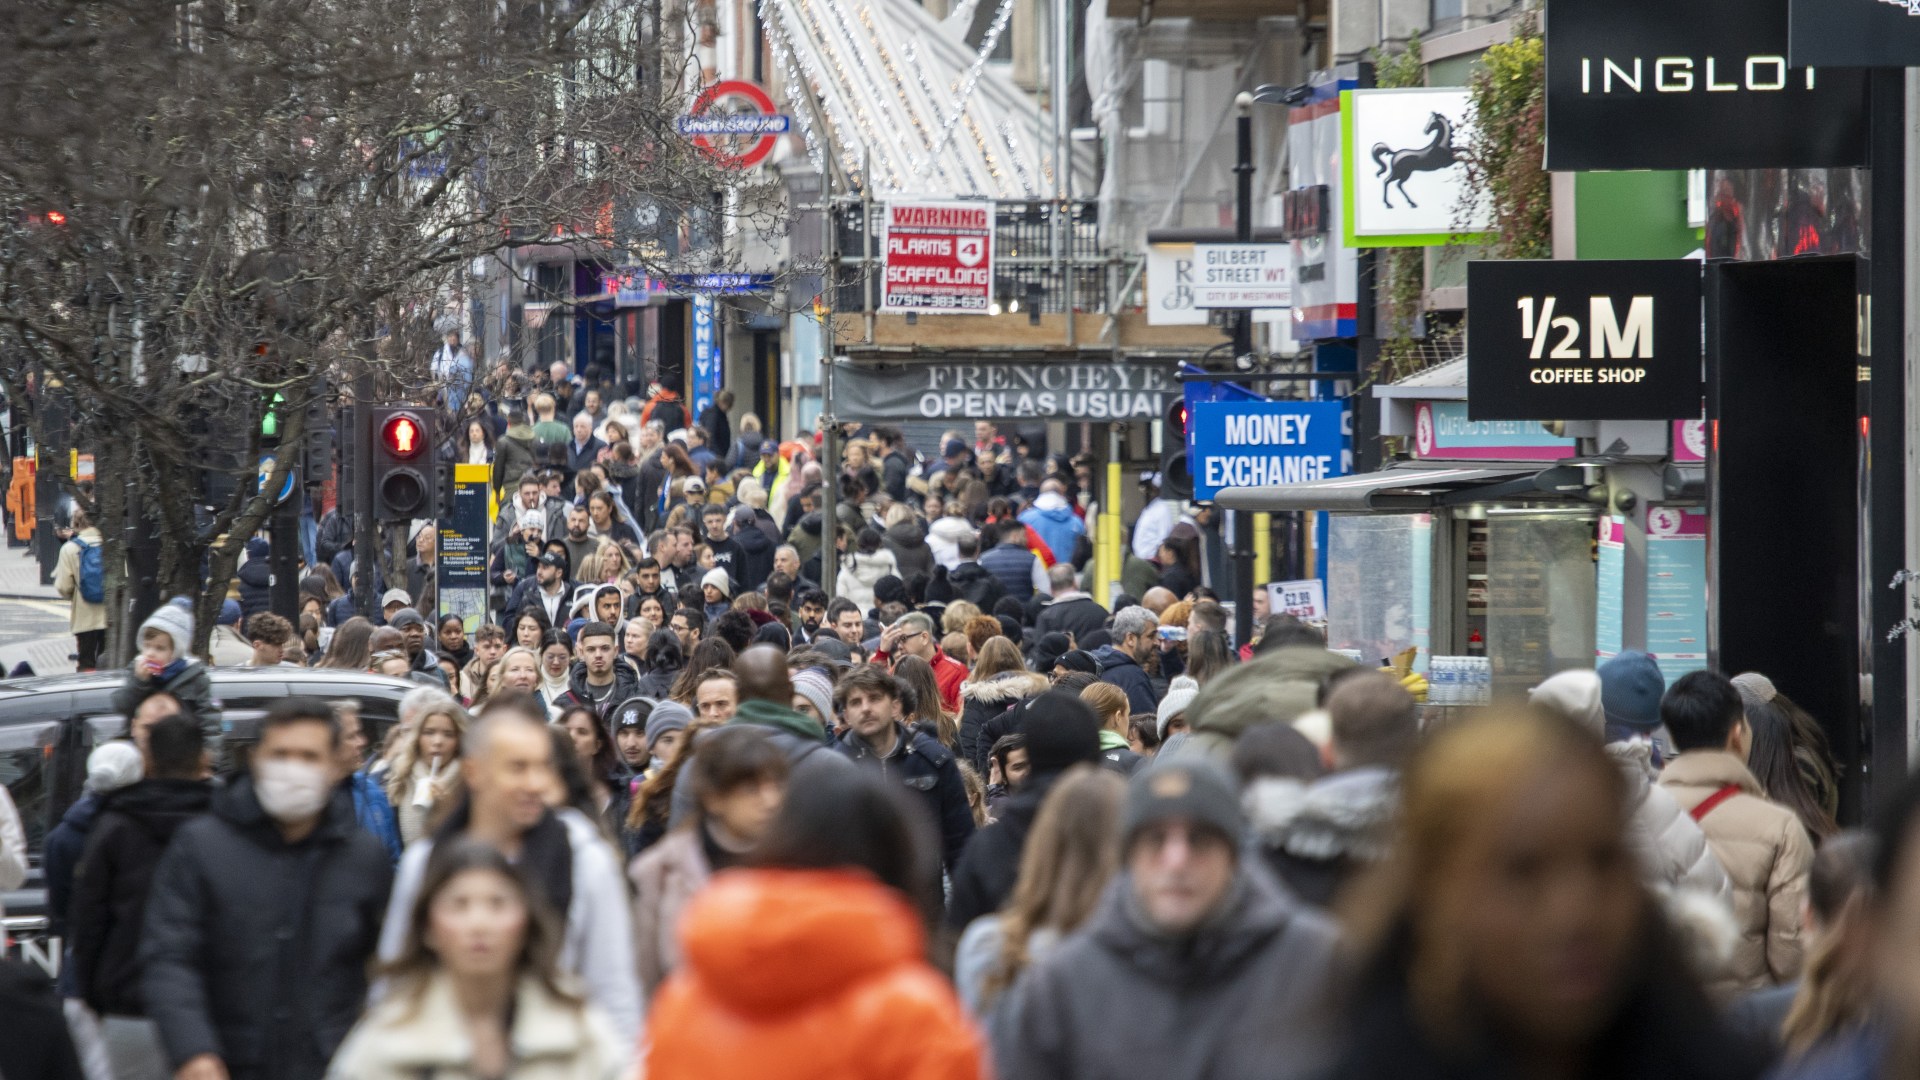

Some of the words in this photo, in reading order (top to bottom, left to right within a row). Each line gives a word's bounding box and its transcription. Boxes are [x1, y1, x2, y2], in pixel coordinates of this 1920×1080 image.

[683, 117, 787, 132] UNDERGROUND
[893, 207, 987, 228] WARNING
[889, 238, 951, 255] ALARMS
[962, 243, 977, 256] 4
[1207, 250, 1266, 265] GILBERT
[888, 267, 987, 284] SCAFFOLDING
[1207, 268, 1260, 282] STREET
[1265, 268, 1286, 281] W1
[1207, 291, 1226, 301] CITY
[1229, 291, 1239, 301] OF
[1530, 367, 1594, 384] COFFEE
[1597, 367, 1646, 383] SHOP
[919, 392, 1005, 418] OPEN
[1013, 392, 1057, 418] AS
[1225, 414, 1311, 446] MONEY
[1205, 455, 1332, 487] EXCHANGE
